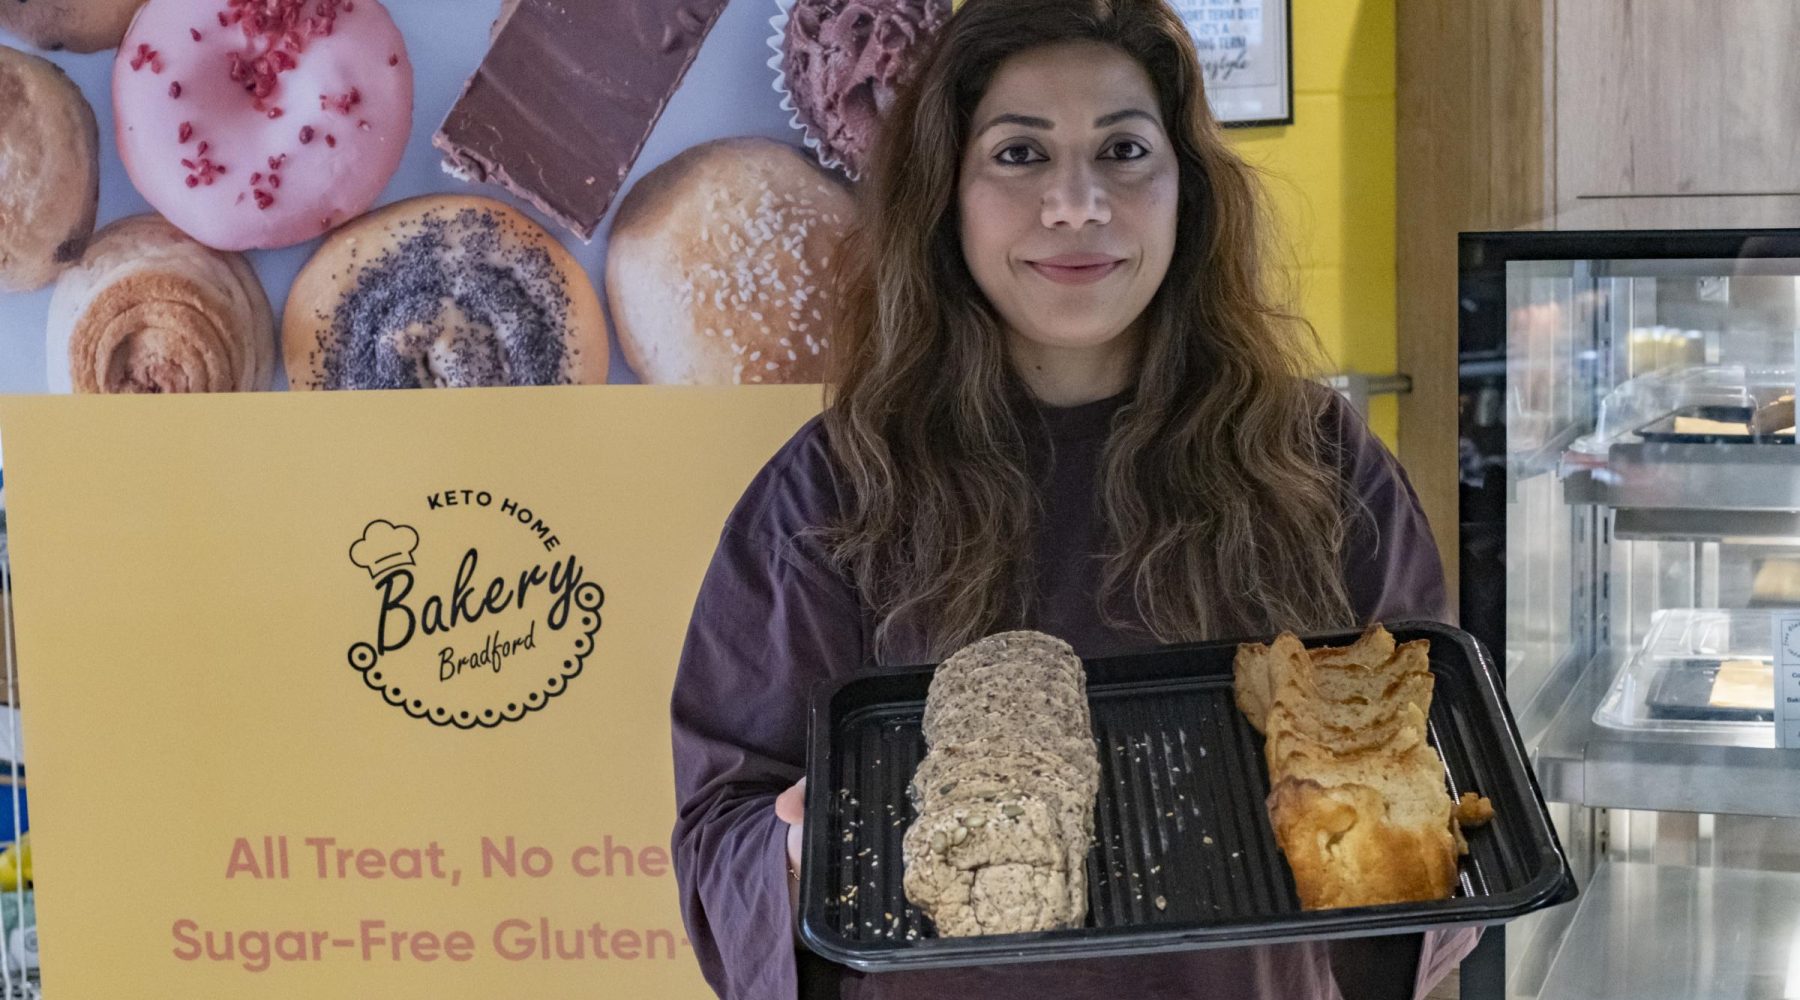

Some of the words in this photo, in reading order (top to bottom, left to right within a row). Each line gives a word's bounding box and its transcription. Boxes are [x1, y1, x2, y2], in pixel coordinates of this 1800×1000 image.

[427, 490, 492, 510] KETO
[500, 498, 561, 552] HOME
[375, 548, 583, 656] Bakery
[438, 620, 536, 682] Bradford
[225, 836, 290, 880] All
[305, 837, 463, 887] Treat,
[481, 836, 554, 879] No
[571, 835, 670, 878] che
[172, 919, 476, 973] Sugar-Free
